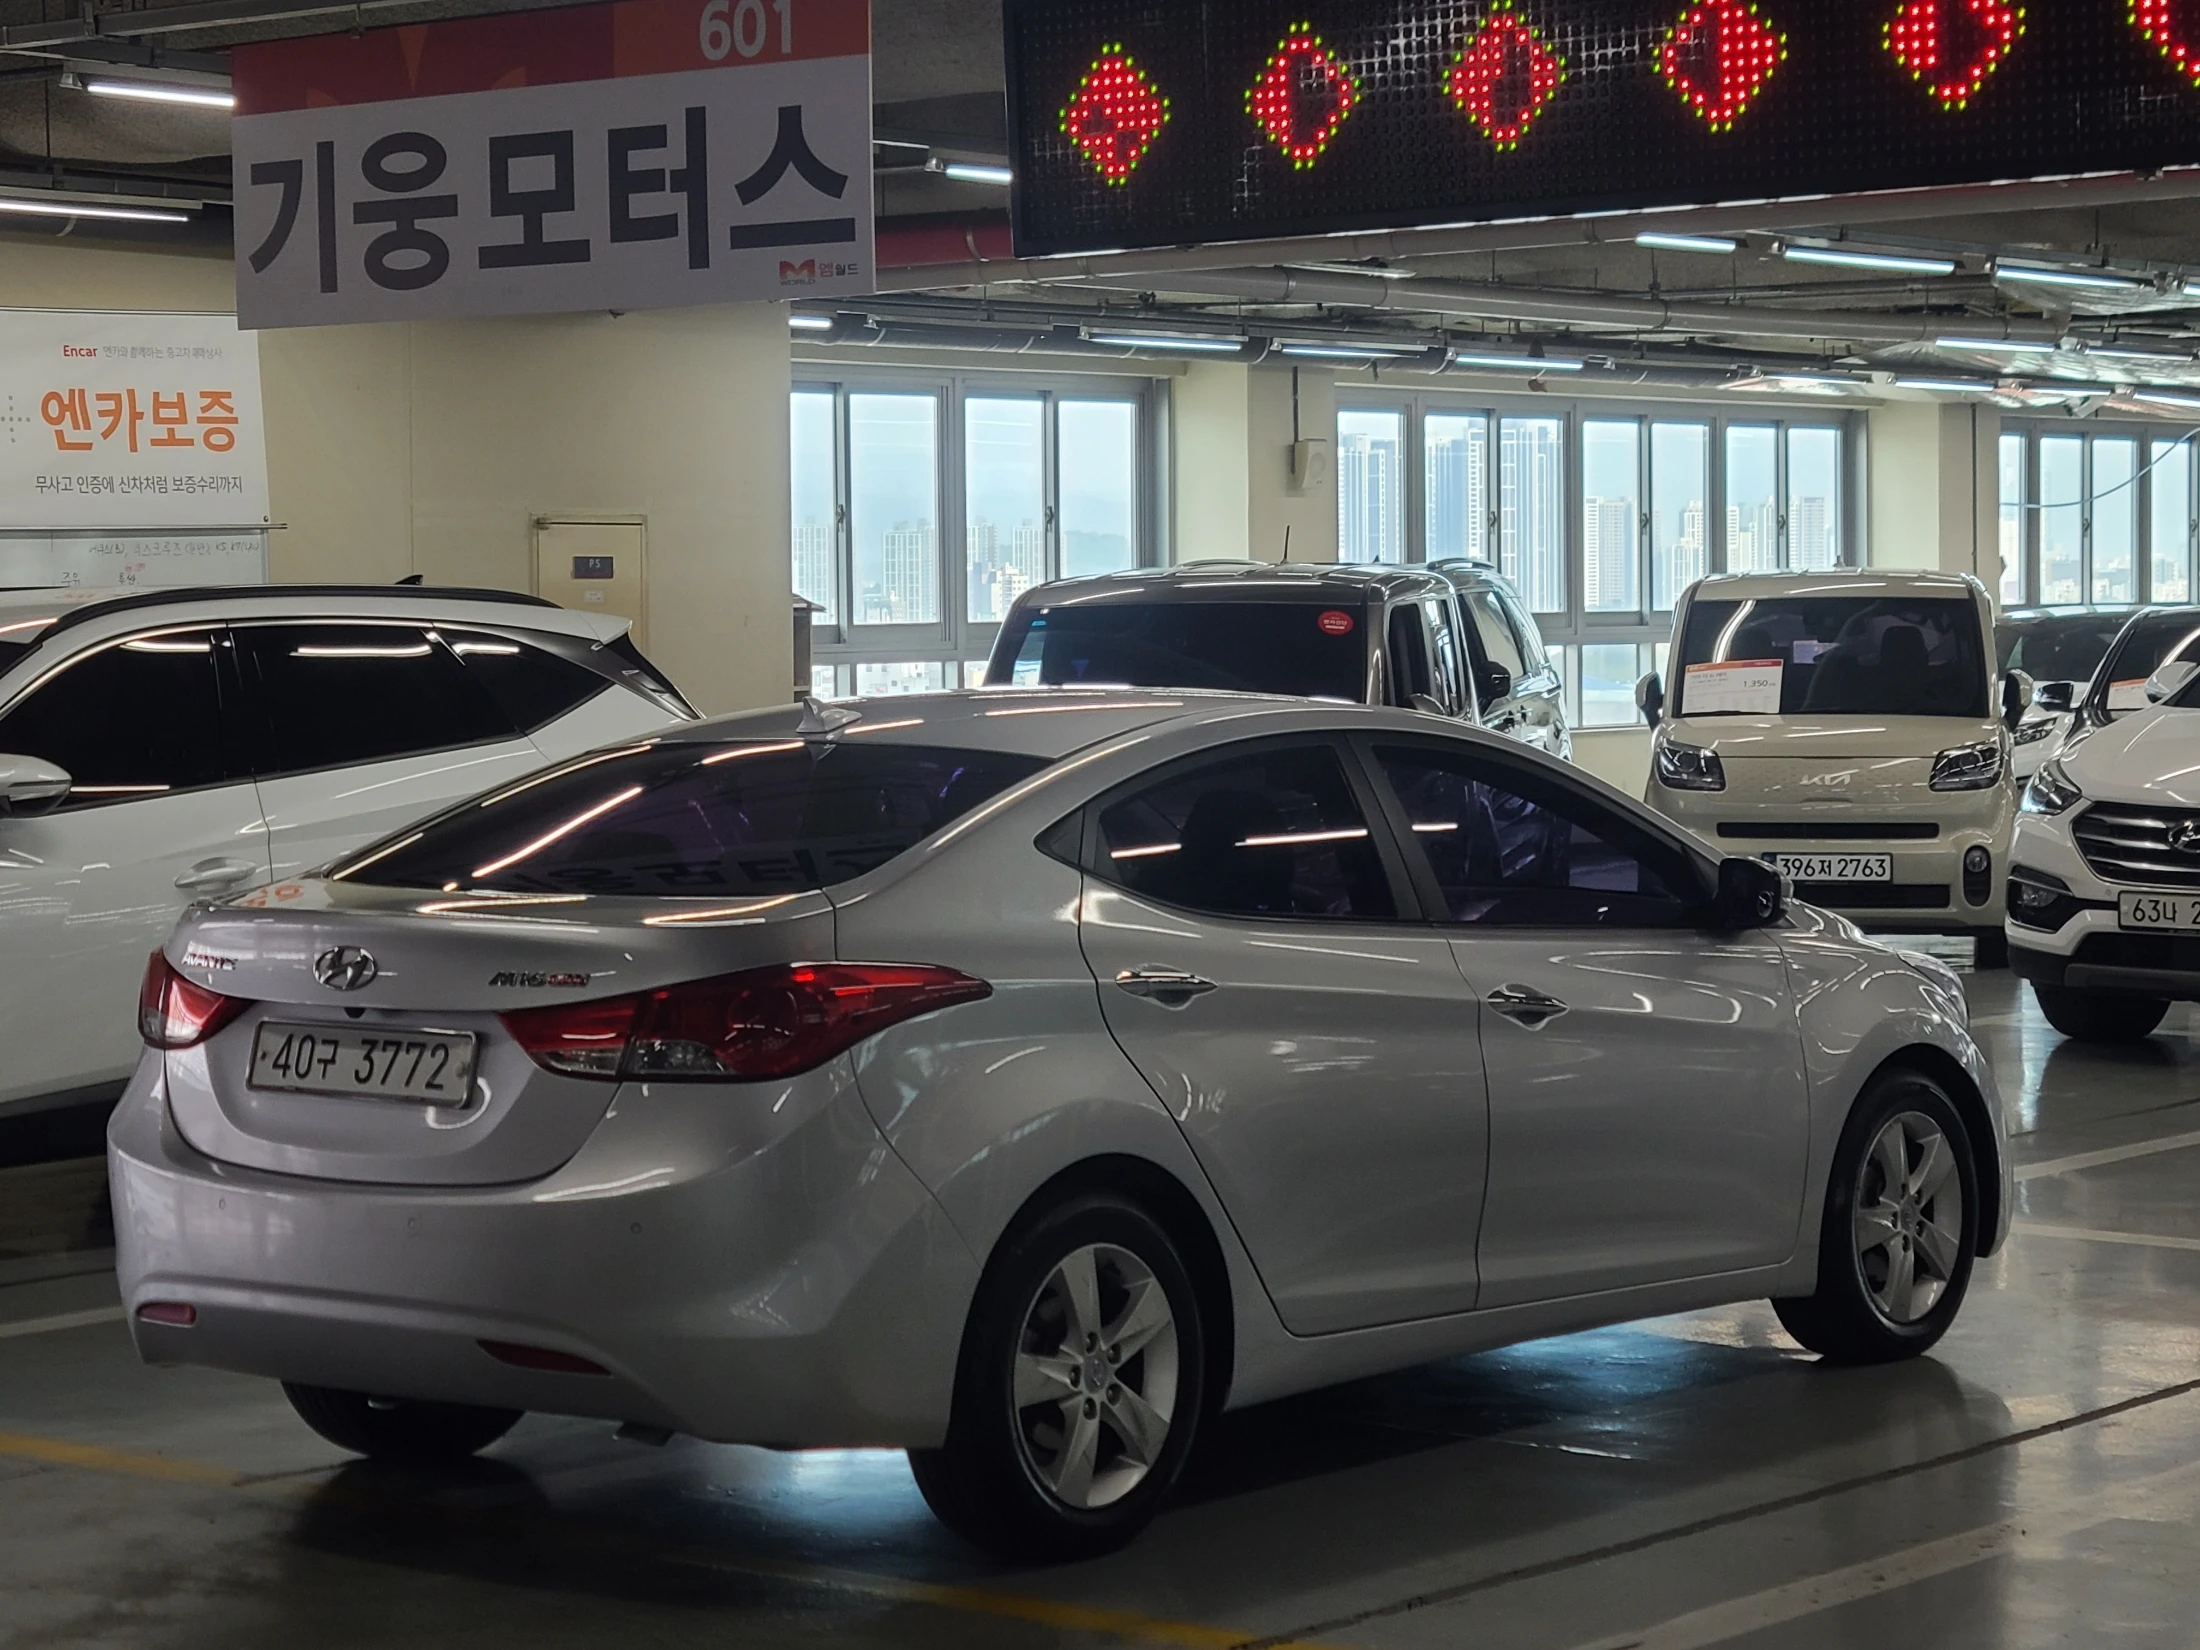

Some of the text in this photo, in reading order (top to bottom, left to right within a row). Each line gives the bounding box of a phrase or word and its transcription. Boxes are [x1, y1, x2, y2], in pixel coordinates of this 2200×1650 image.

[700, 0, 792, 61] 601
[248, 104, 857, 294] 기웅모터스
[818, 262, 859, 278] 엠월드
[63, 345, 98, 358] Encar
[40, 388, 239, 453] 엔카보증
[35, 475, 243, 494] 무사고 인증에 신차처럼 보증수리까지
[1743, 680, 1768, 688] 1,350
[1780, 858, 1887, 877] 396저 2763
[2133, 898, 2177, 923] 63나
[272, 1033, 450, 1091] 40구 3772
